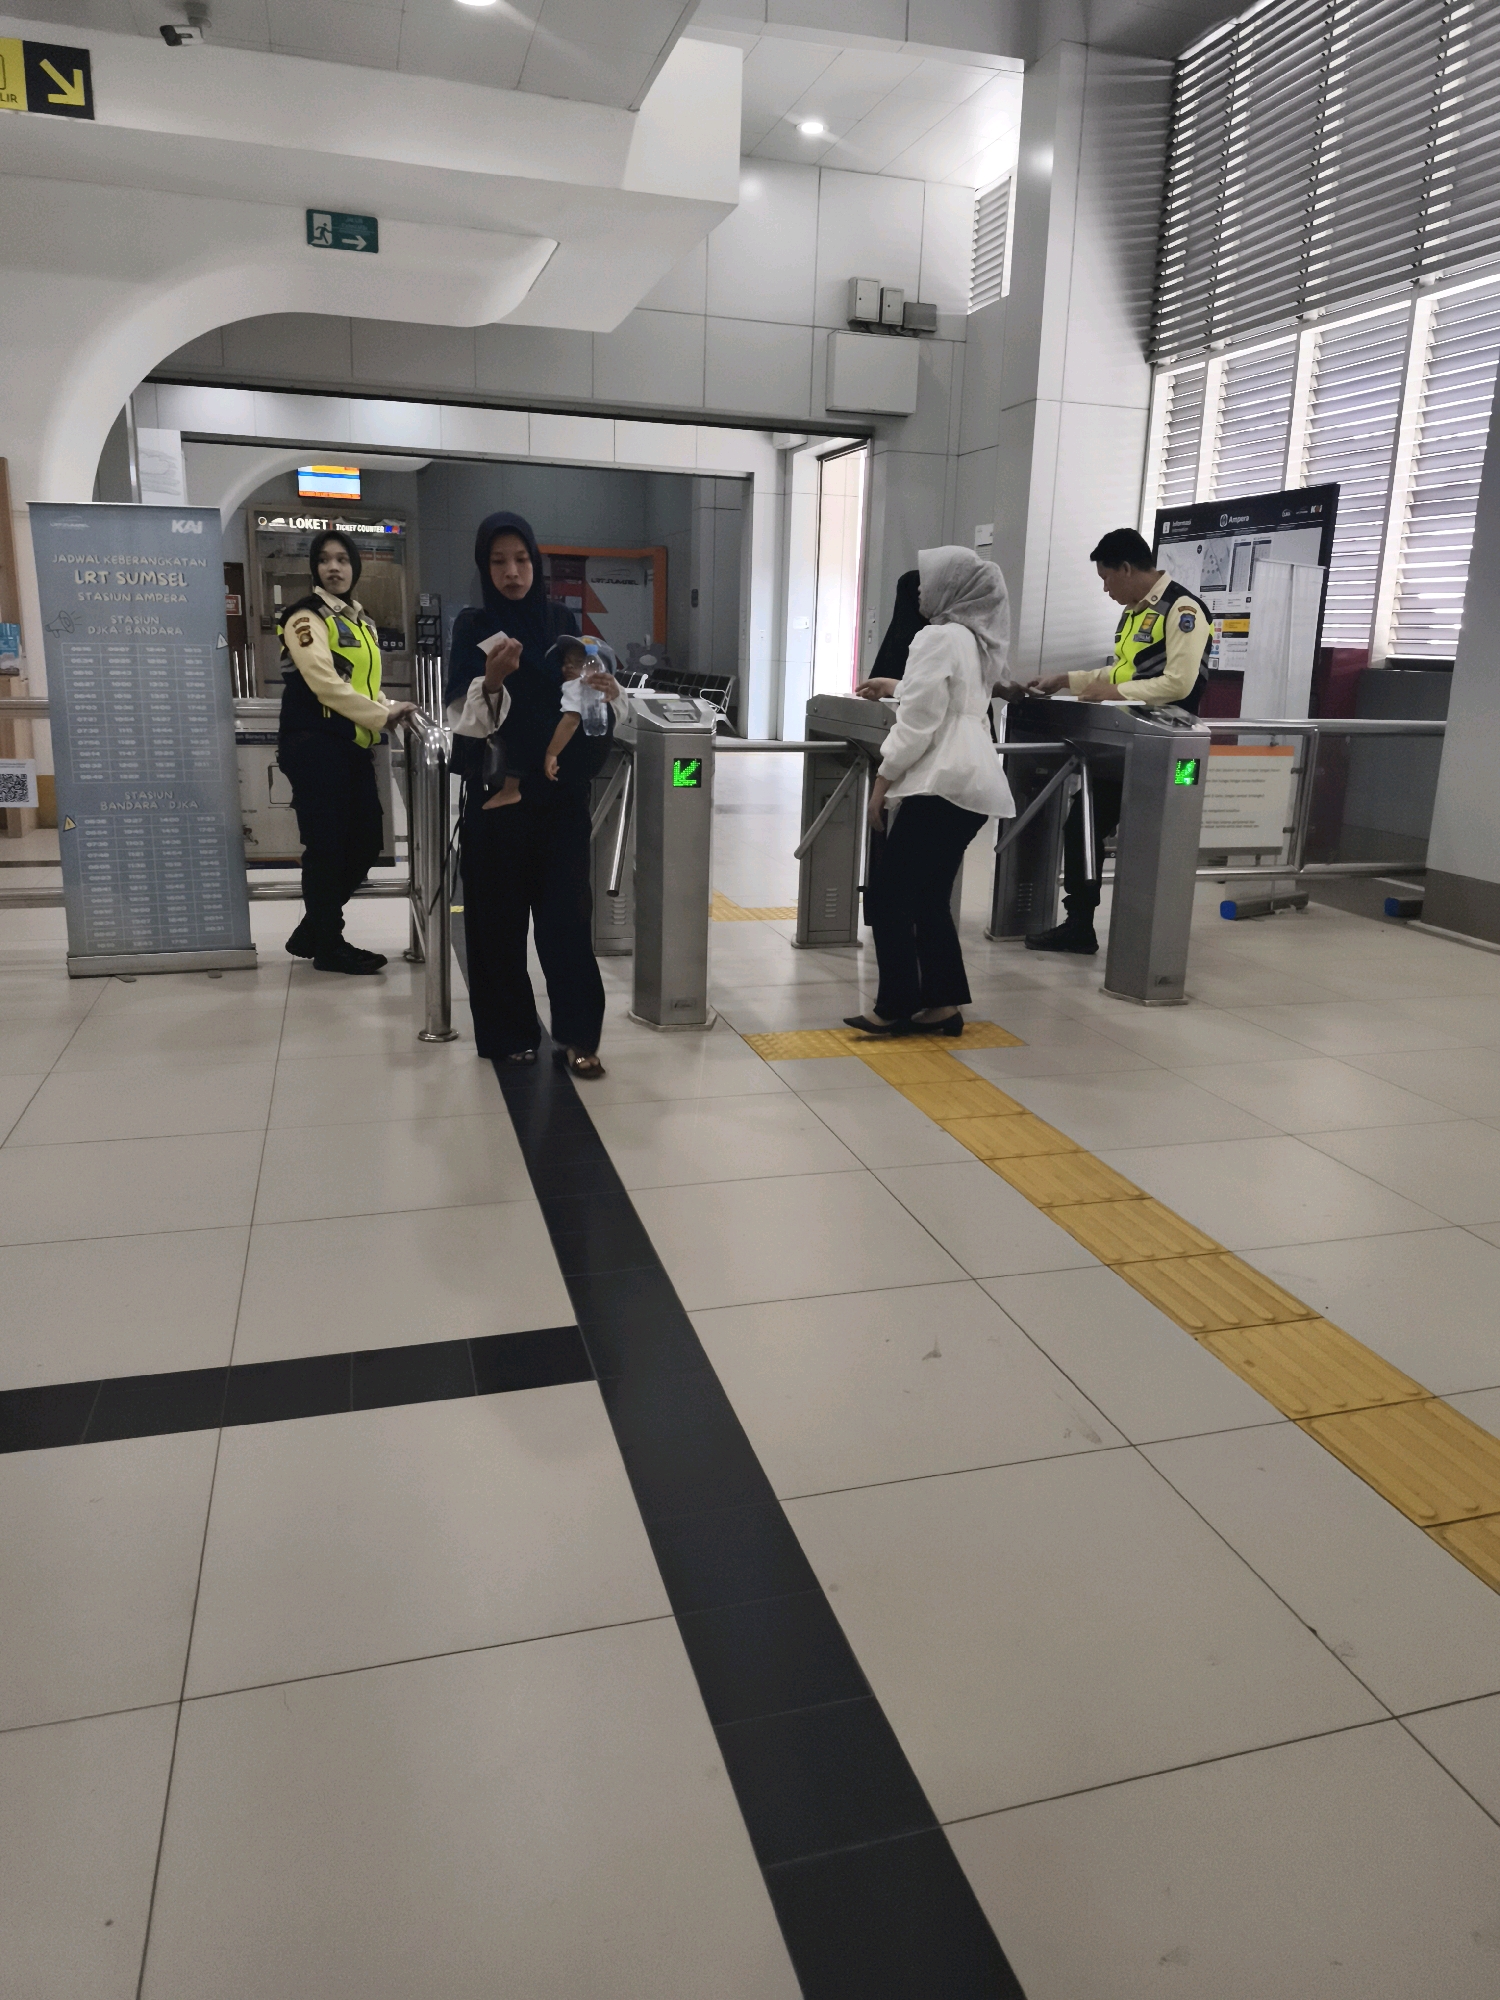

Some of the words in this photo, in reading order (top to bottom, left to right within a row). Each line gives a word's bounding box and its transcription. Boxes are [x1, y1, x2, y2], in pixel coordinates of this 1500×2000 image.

[171, 519, 203, 534] KAI
[288, 517, 329, 530] LOKET
[52, 554, 101, 565] JADWAL
[103, 555, 207, 567] KEBERANGKATAN
[74, 570, 110, 585] LRT
[116, 571, 189, 587] SUMSEL
[77, 592, 132, 602] STASIUN
[135, 593, 188, 603] AMPERA
[110, 615, 160, 625] STASIUN
[124, 791, 174, 801] STASIUN
[100, 800, 159, 811] BANDARA
[169, 801, 199, 810] DJKA
